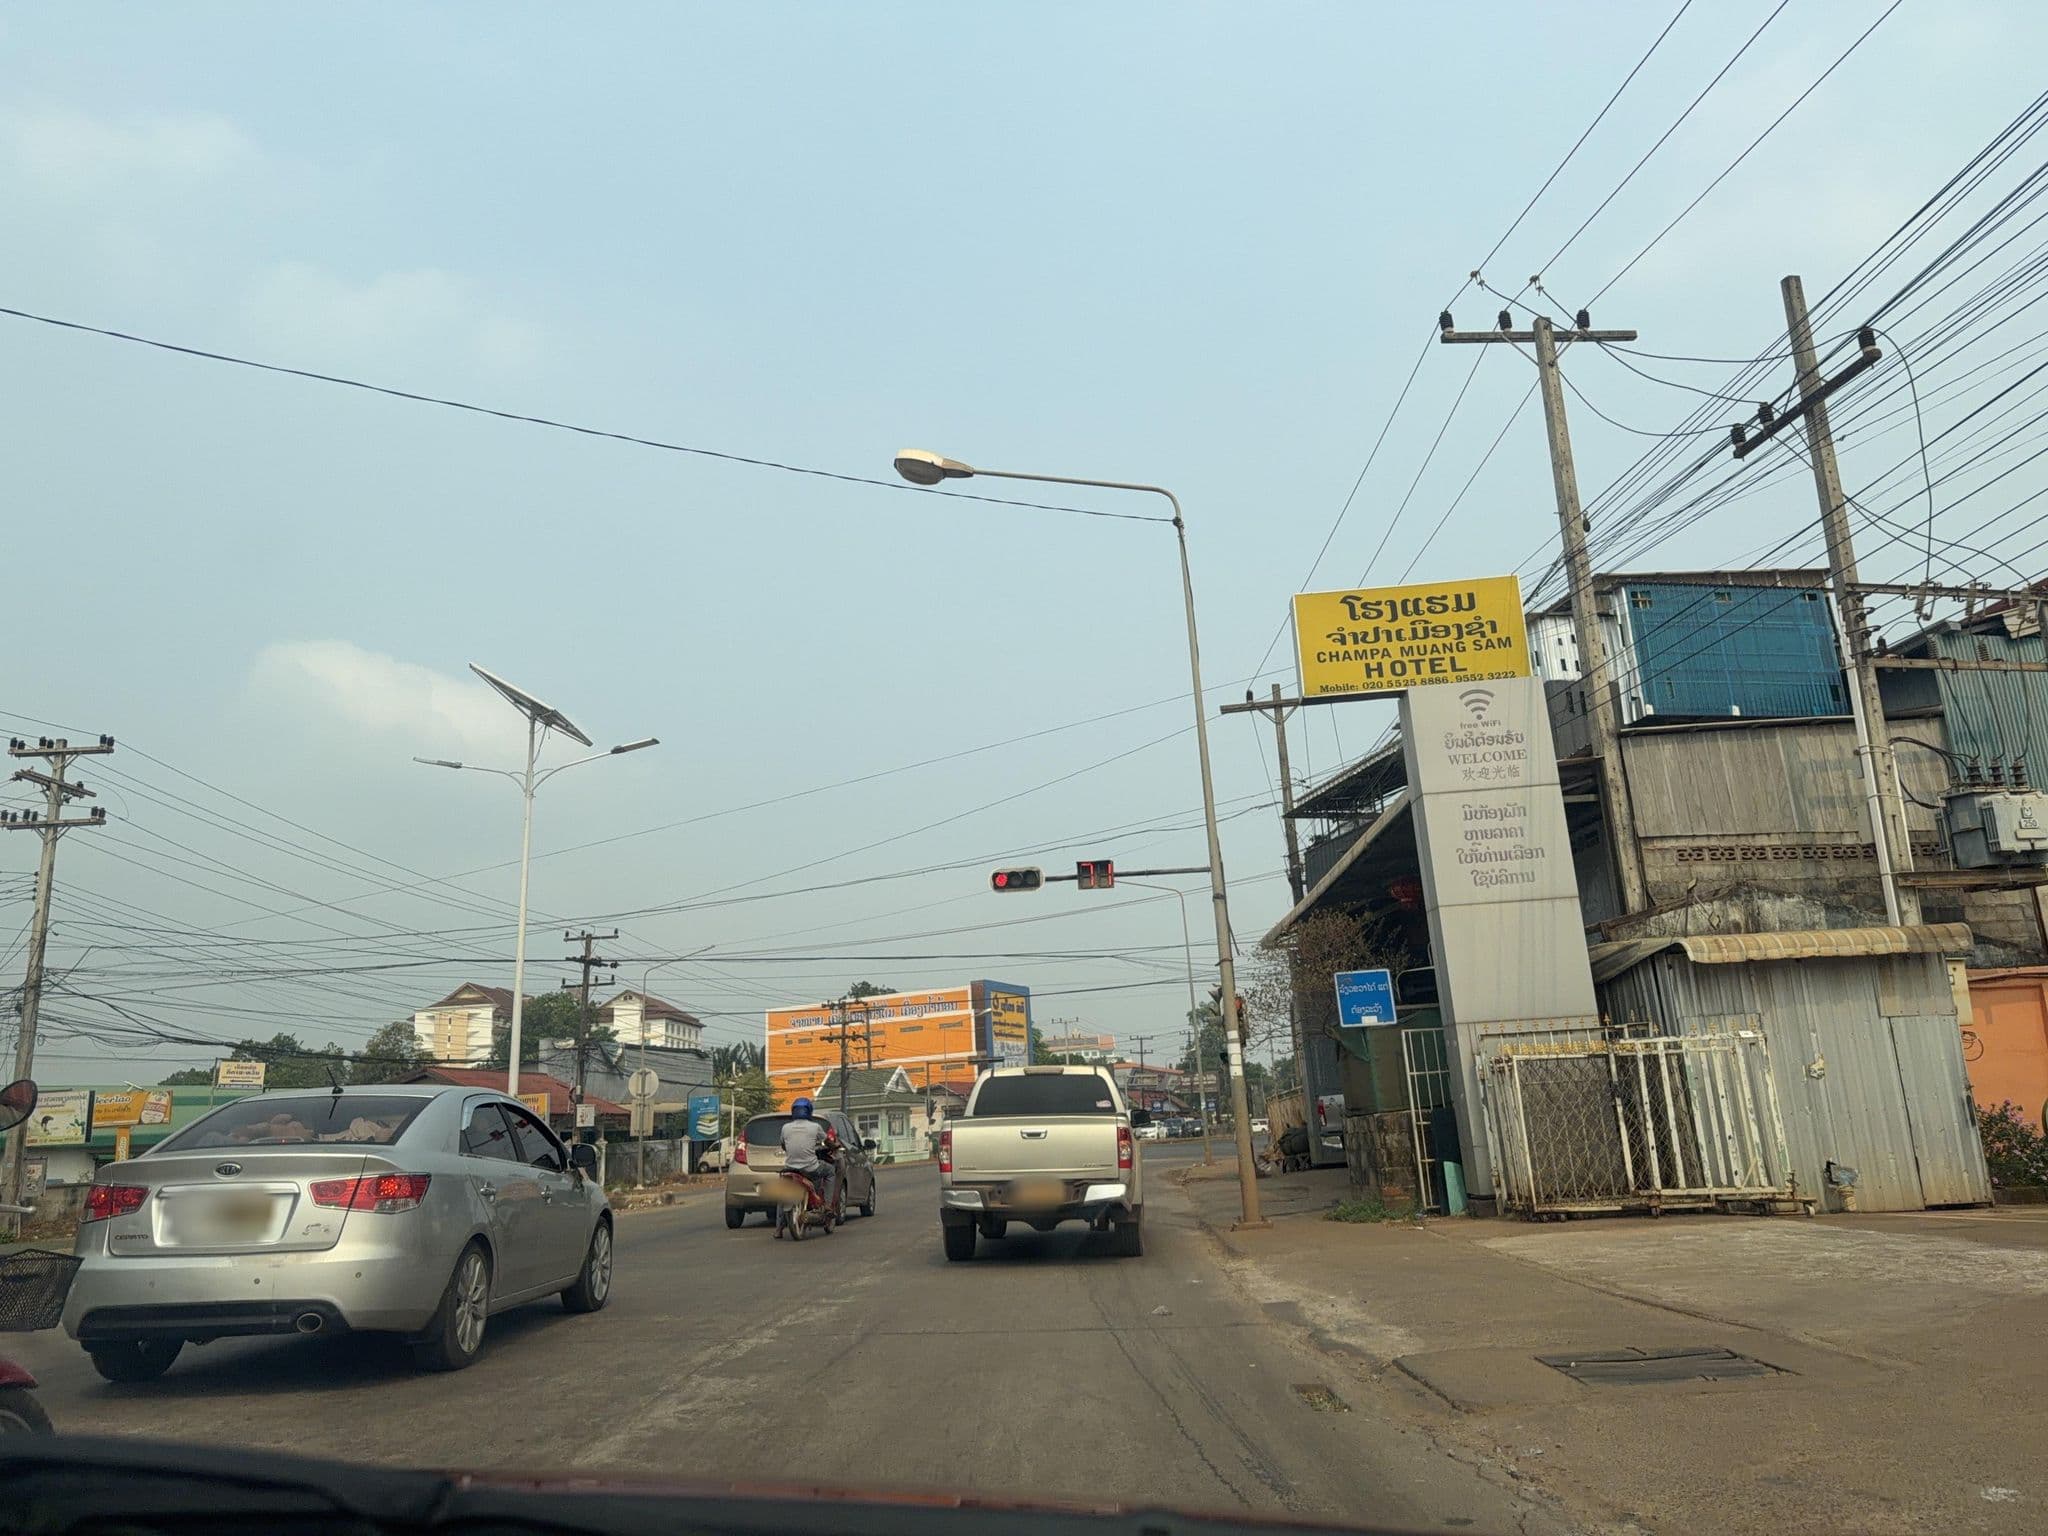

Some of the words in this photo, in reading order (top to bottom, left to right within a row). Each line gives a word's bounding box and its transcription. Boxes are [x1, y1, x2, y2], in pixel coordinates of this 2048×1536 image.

[1339, 592, 1477, 623] ໂຮງແຮມ
[1316, 647, 1392, 664] CHAMPA
[1400, 640, 1467, 657] MUANG
[1473, 636, 1513, 651] SAM
[1364, 656, 1468, 679] HOTEL
[1319, 682, 1359, 693] Mobile:
[1362, 681, 1383, 690] 020
[1387, 678, 1417, 688] 5525
[1455, 673, 1485, 683] 9552
[1487, 670, 1517, 681] 3222
[1448, 749, 1527, 765] WELCOME
[1462, 764, 1521, 781] 欢迎光临
